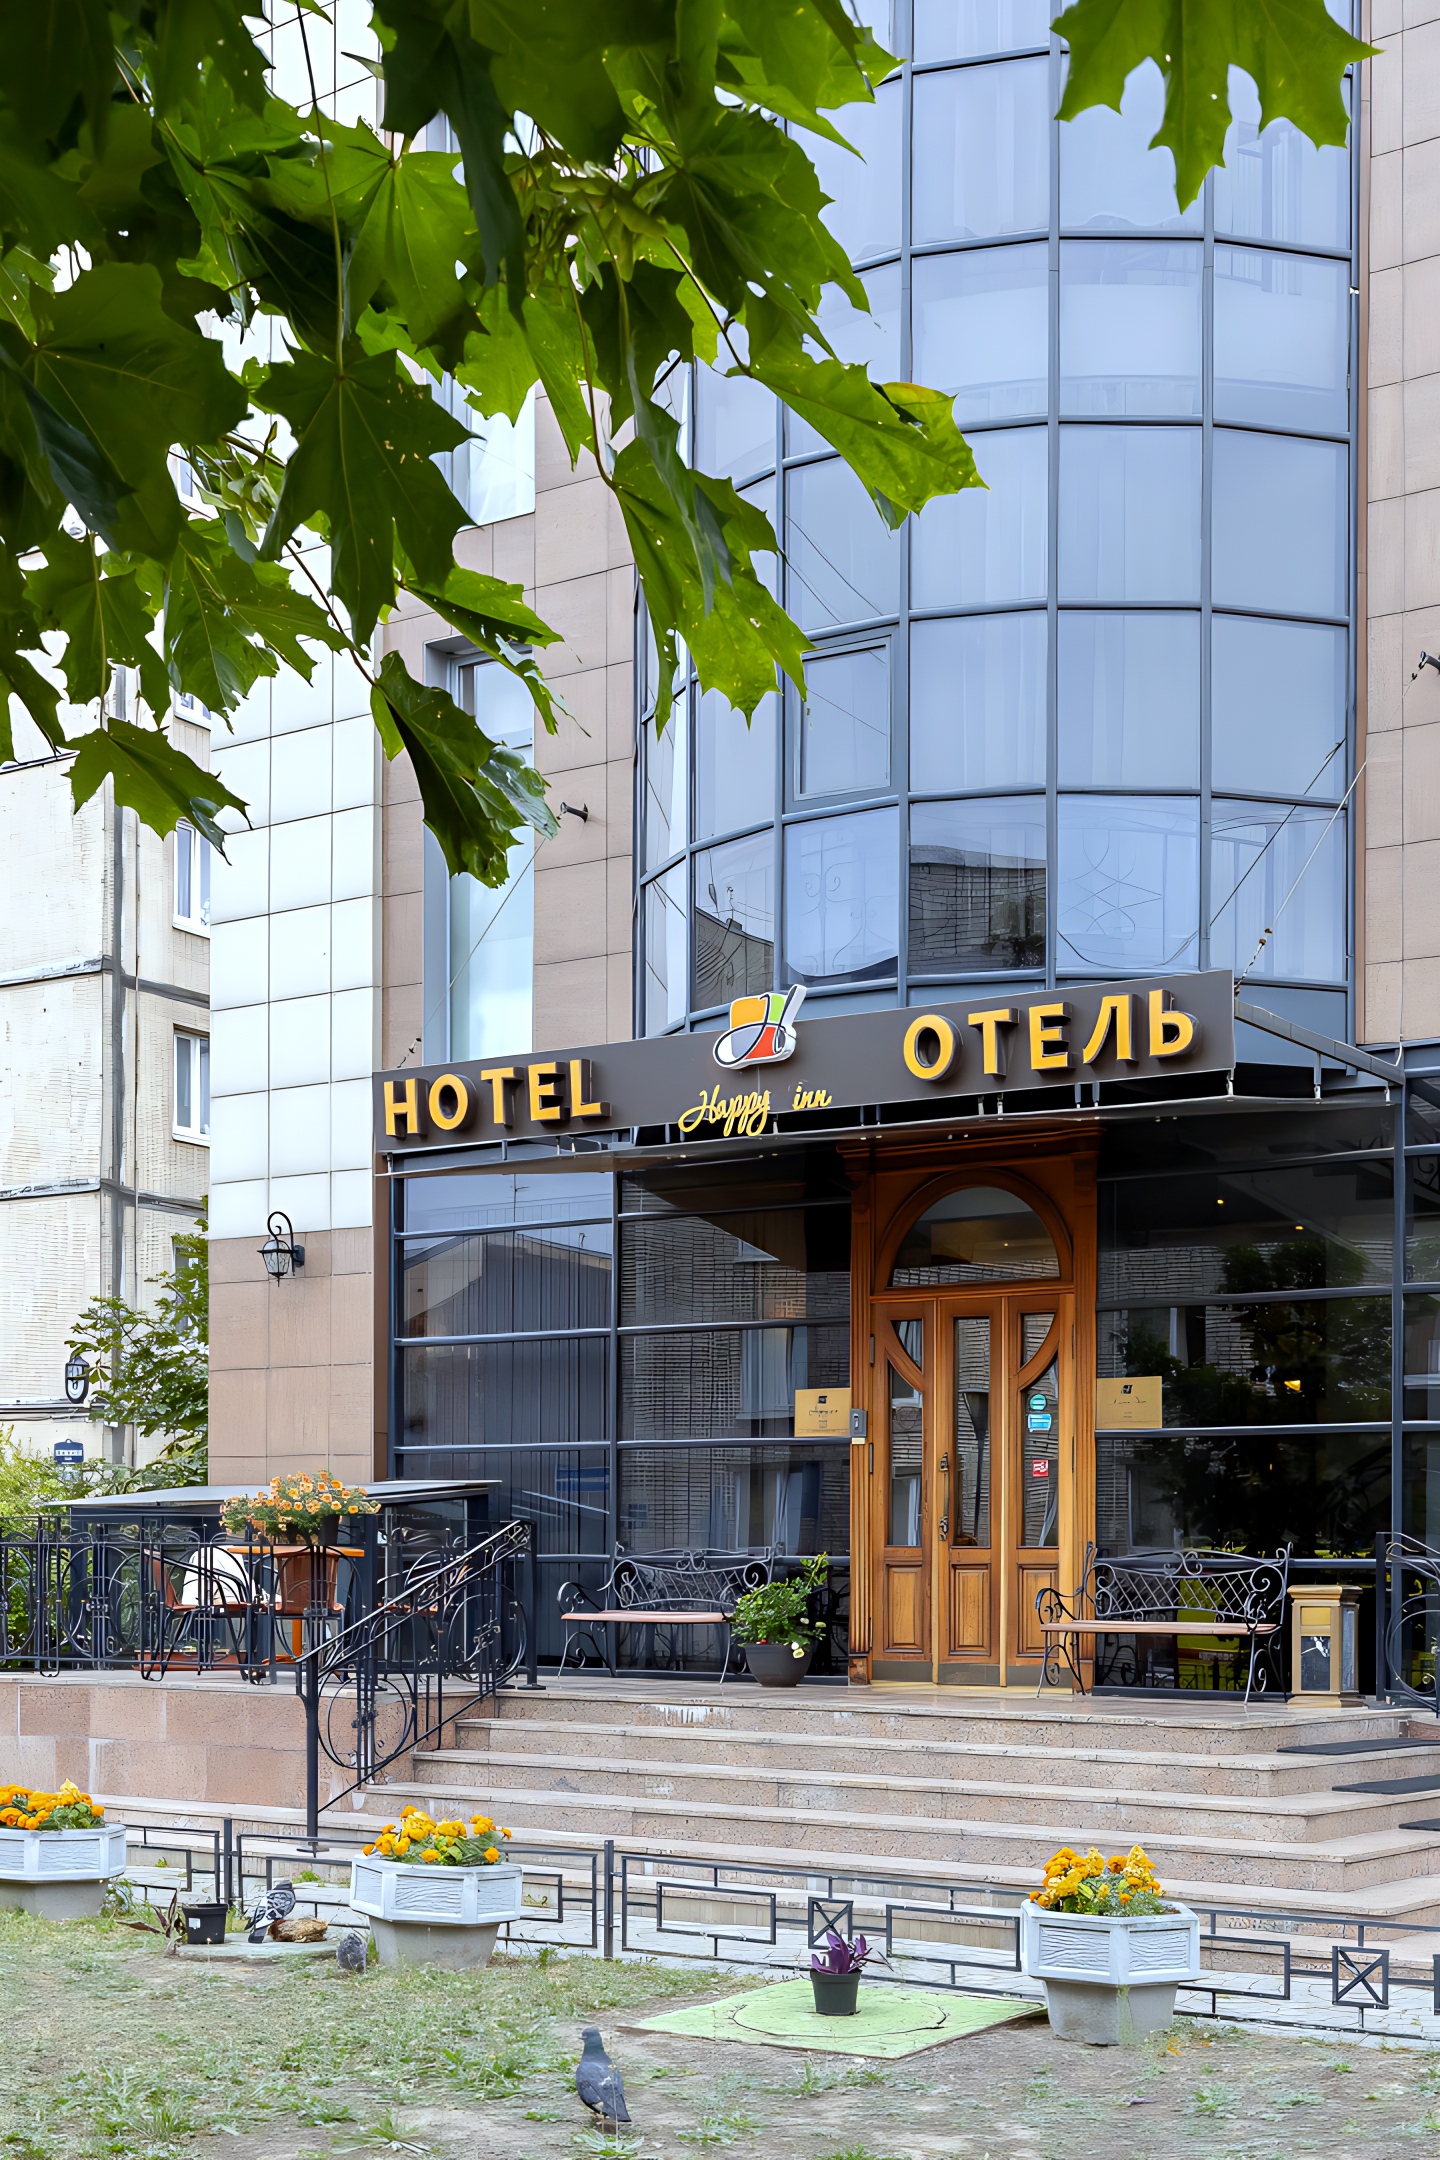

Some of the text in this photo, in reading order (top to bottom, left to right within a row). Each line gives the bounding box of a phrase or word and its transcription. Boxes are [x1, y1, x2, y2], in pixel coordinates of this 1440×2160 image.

[902, 988, 1196, 1081] ОТЕЛЬ
[383, 1058, 603, 1137] HOTEL
[678, 1082, 833, 1137] Happy inn
